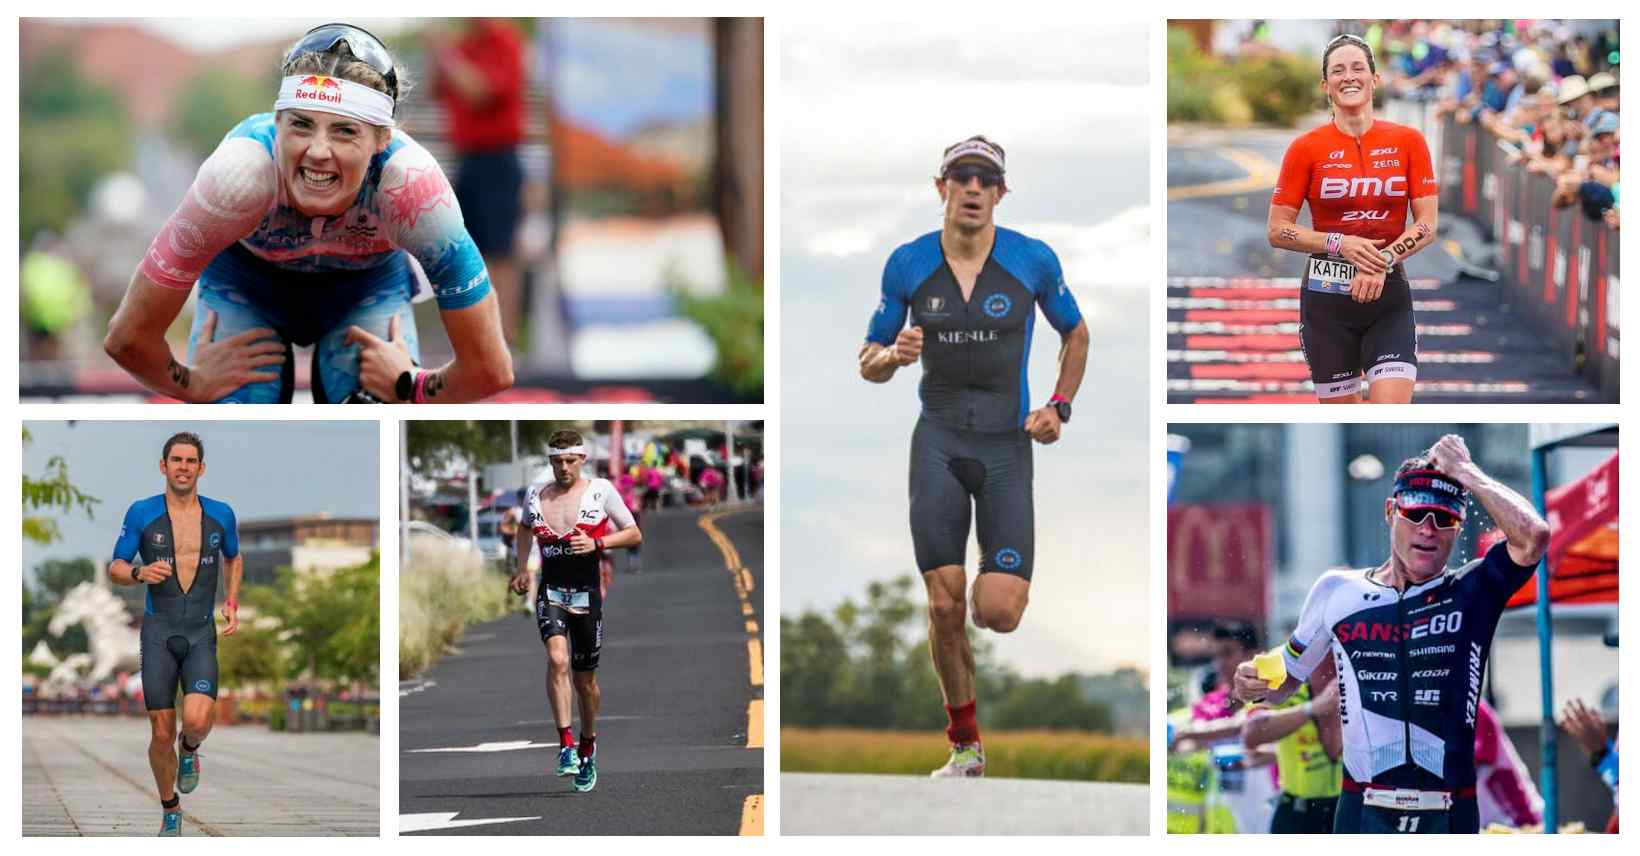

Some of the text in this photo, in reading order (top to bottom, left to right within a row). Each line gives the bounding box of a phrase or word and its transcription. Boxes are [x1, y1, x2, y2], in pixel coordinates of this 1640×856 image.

[295, 89, 342, 103] Red Bull
[1320, 176, 1407, 199] BMC
[1341, 210, 1390, 221] 2XU
[938, 330, 999, 344] KIENLE
[1409, 644, 1456, 658] SHIMANO
[1465, 641, 1482, 730] TRIMTEX
[1371, 691, 1398, 701] TYR
[1397, 815, 1420, 833] 11
